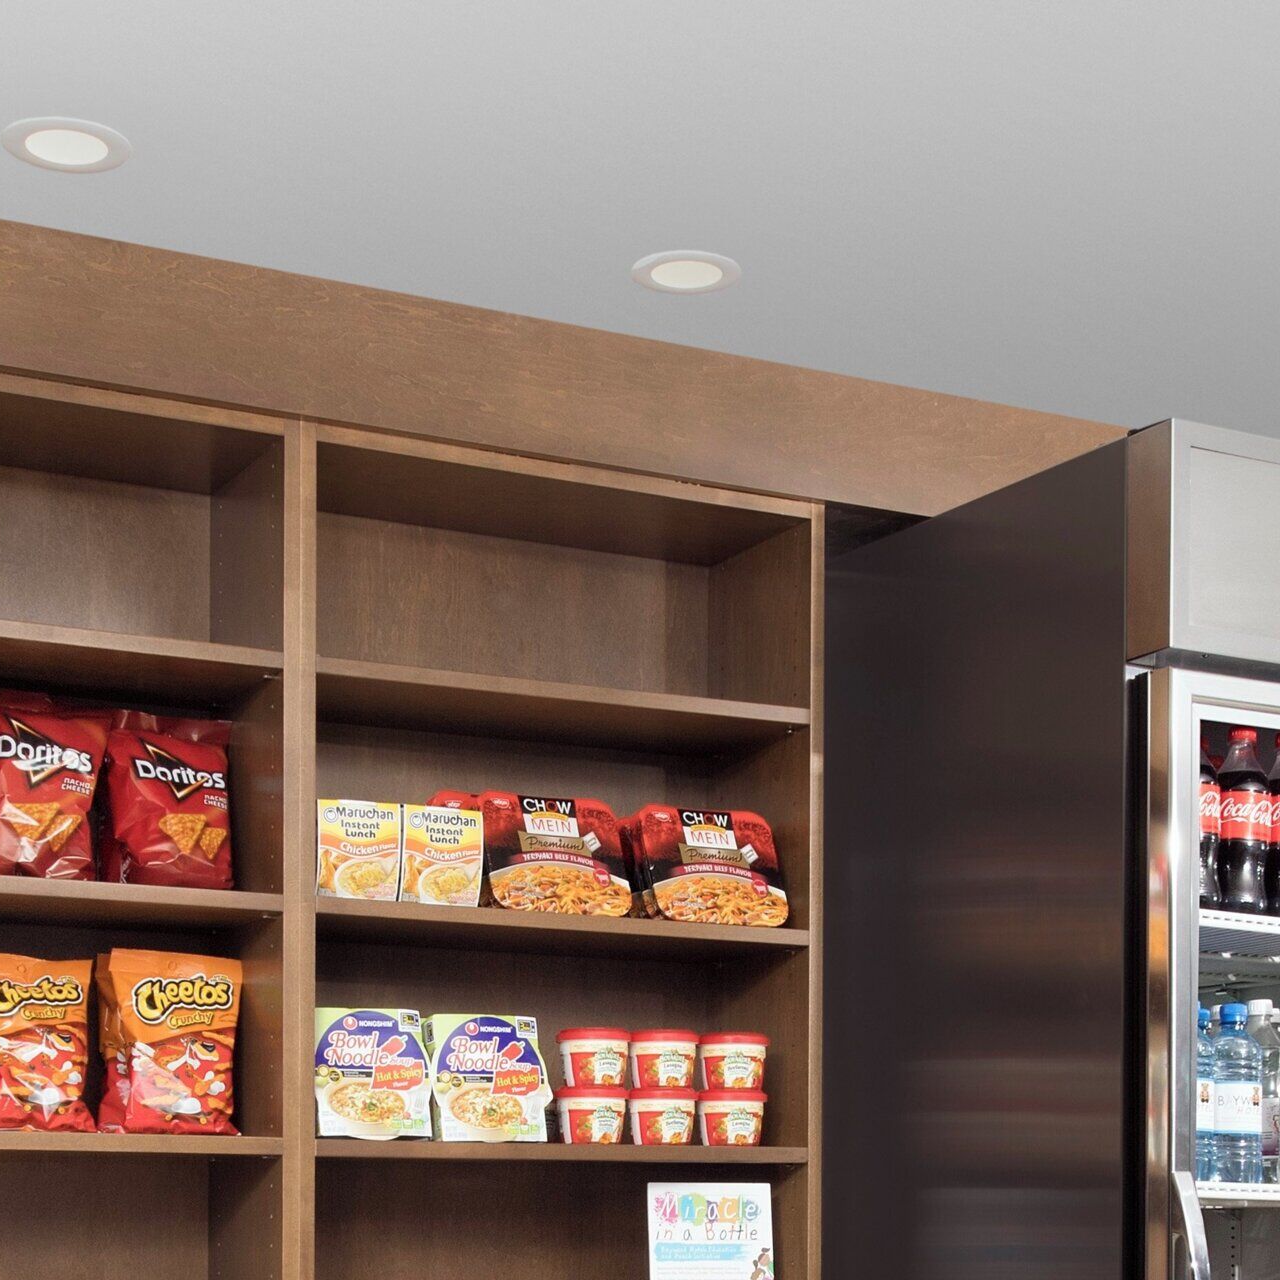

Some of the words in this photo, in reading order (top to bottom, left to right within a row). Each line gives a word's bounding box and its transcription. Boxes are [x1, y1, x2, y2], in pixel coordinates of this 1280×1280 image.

[134, 758, 226, 789] Doritos
[336, 806, 394, 821] Maruchan
[523, 798, 572, 815] CHOW
[341, 820, 380, 830] Instant
[422, 812, 477, 828] Maruchan
[530, 819, 572, 833] MEIN
[682, 811, 728, 828] CHOW
[345, 829, 376, 839] Lunch
[426, 827, 464, 837] Instant
[690, 830, 730, 845] MEIN
[429, 835, 460, 845] Lunch
[524, 836, 585, 851] Premium
[340, 842, 380, 855] Chicken
[424, 847, 462, 861] Chicken
[685, 848, 743, 863] Premium
[554, 853, 569, 861] BEEF
[570, 854, 595, 867] FLAVOR
[714, 865, 728, 874] BEEF
[729, 866, 753, 878] FLAVOR
[133, 974, 234, 1024] Cheetos
[21, 1006, 67, 1020] Crunchy
[168, 1011, 213, 1029] Crunchy
[358, 1020, 394, 1028] NONGSHIM
[479, 1025, 512, 1034] NONGSHIM
[328, 1030, 380, 1050] Bowl
[450, 1036, 500, 1055] Bowl
[324, 1048, 392, 1067] Noodle
[446, 1053, 510, 1072] Noodle
[375, 1071, 392, 1082] Hot
[400, 1067, 422, 1081] Spicy
[496, 1077, 511, 1087] Hot
[519, 1072, 540, 1084] Spicy
[660, 1193, 757, 1220] Miracle
[656, 1223, 673, 1240] in
[683, 1228, 693, 1241] a
[705, 1222, 758, 1241] Bottle
